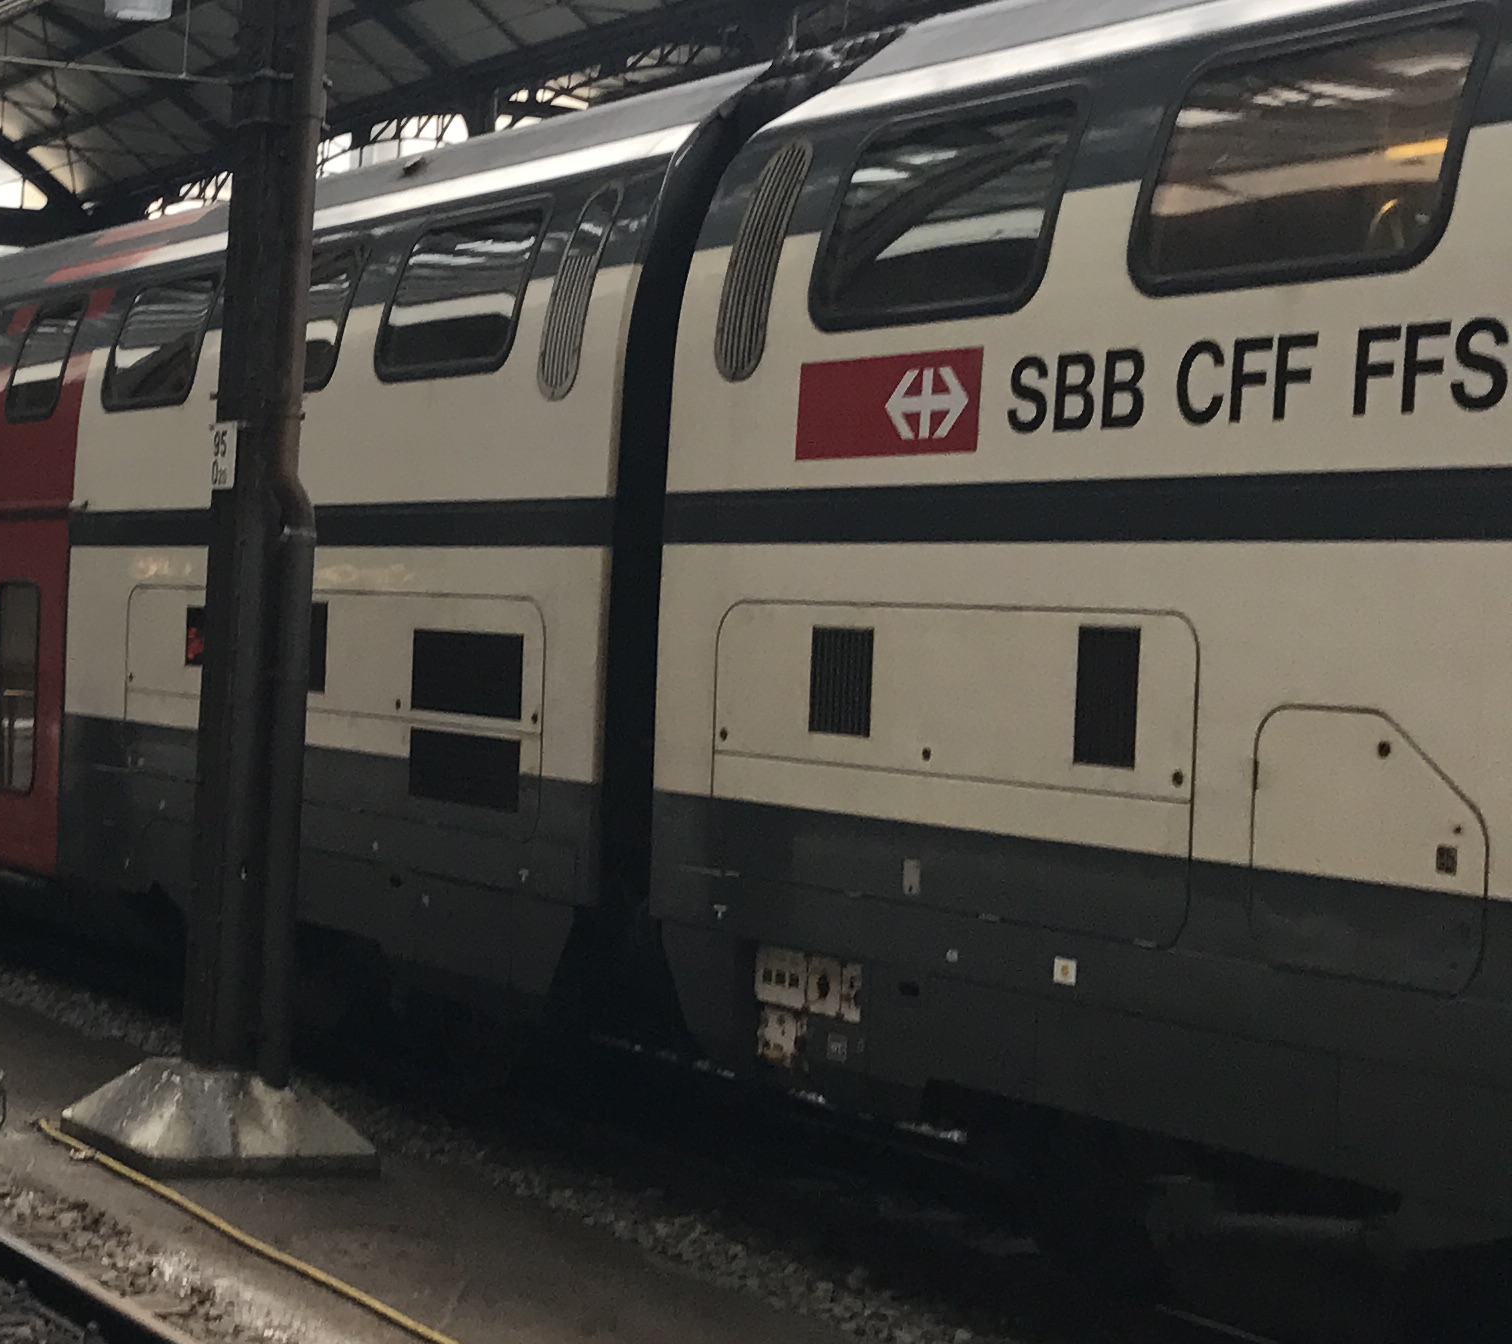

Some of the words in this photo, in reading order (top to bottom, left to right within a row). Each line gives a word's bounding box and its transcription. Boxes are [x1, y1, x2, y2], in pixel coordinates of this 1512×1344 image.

[1006, 346, 1146, 435] SBB
[1175, 330, 1320, 427] CFF
[1352, 315, 1511, 419] FFS
[213, 430, 228, 457] 95
